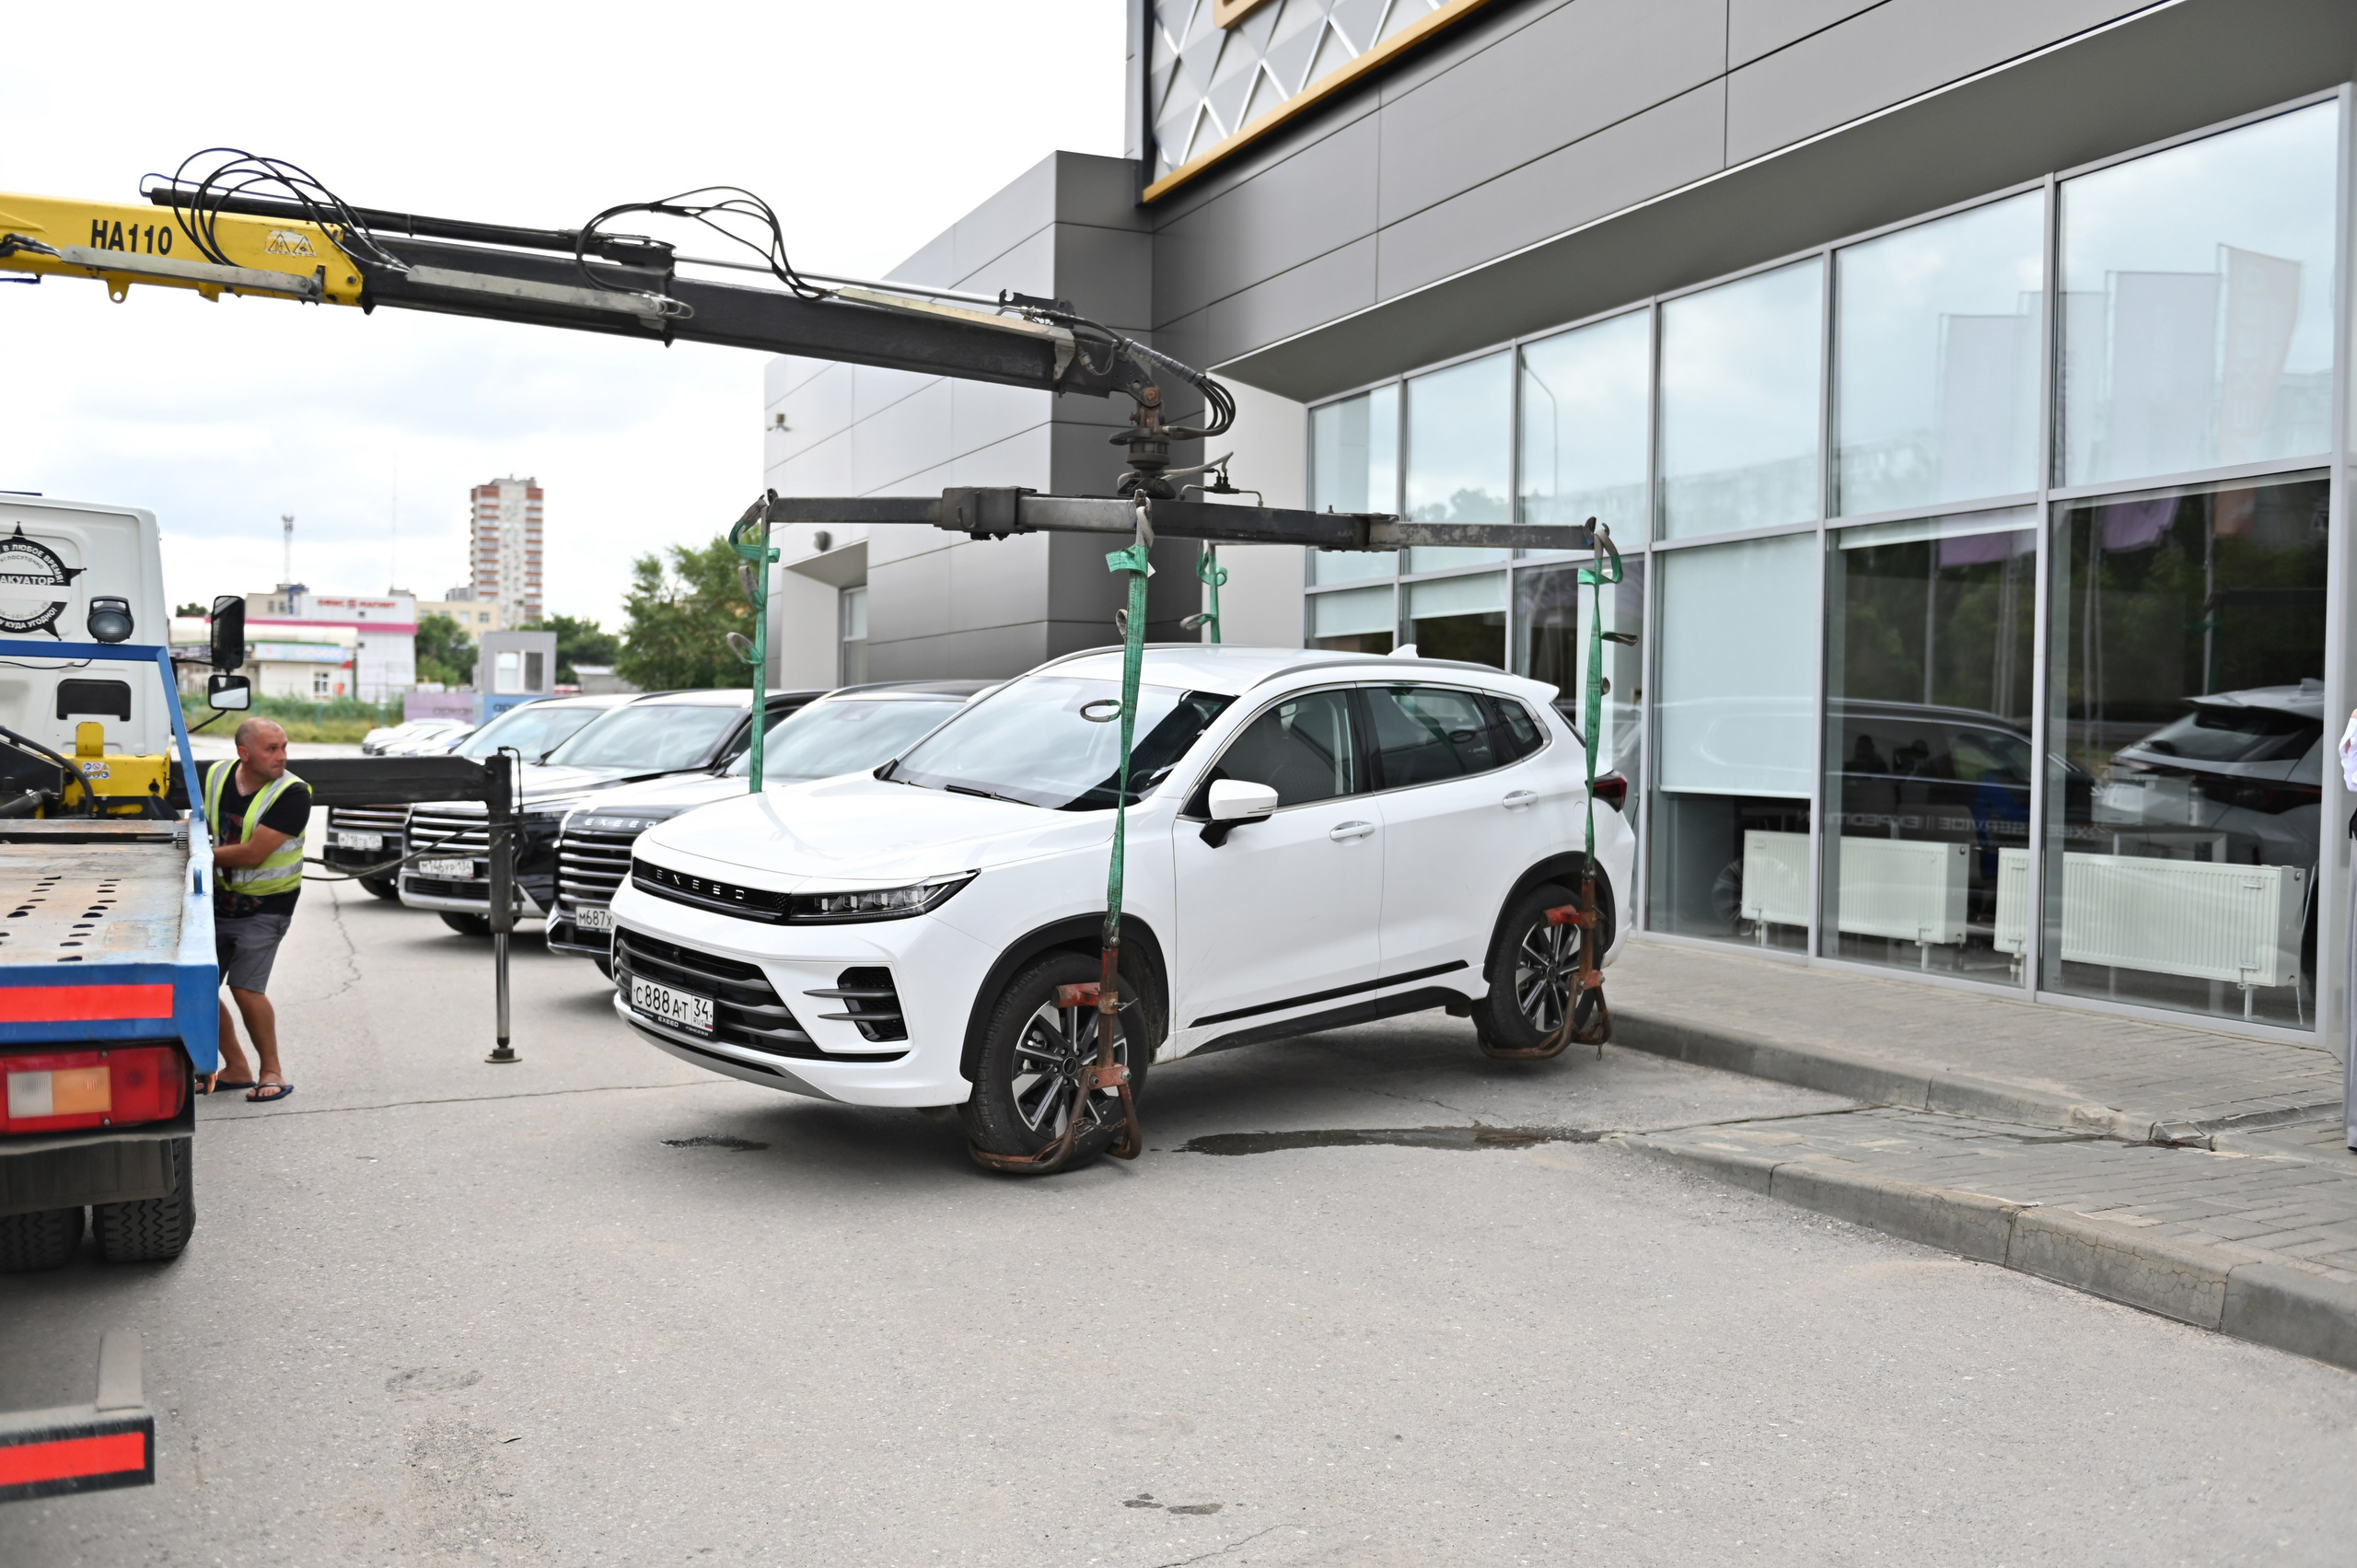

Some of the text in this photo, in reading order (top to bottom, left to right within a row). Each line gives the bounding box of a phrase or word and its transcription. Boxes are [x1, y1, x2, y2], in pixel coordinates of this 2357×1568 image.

[91, 219, 173, 256] HA110
[12, 544, 44, 557] ЛЮБОЕ
[43, 555, 64, 583] ВРЕМЯ!
[6, 621, 27, 630] КУДА
[28, 608, 58, 628] УГОДНО!
[585, 818, 657, 829] EXEED
[656, 869, 745, 900] EXEED
[693, 997, 709, 1020] 34
[657, 1015, 679, 1028] EXEED
[692, 1016, 705, 1027] RUS
